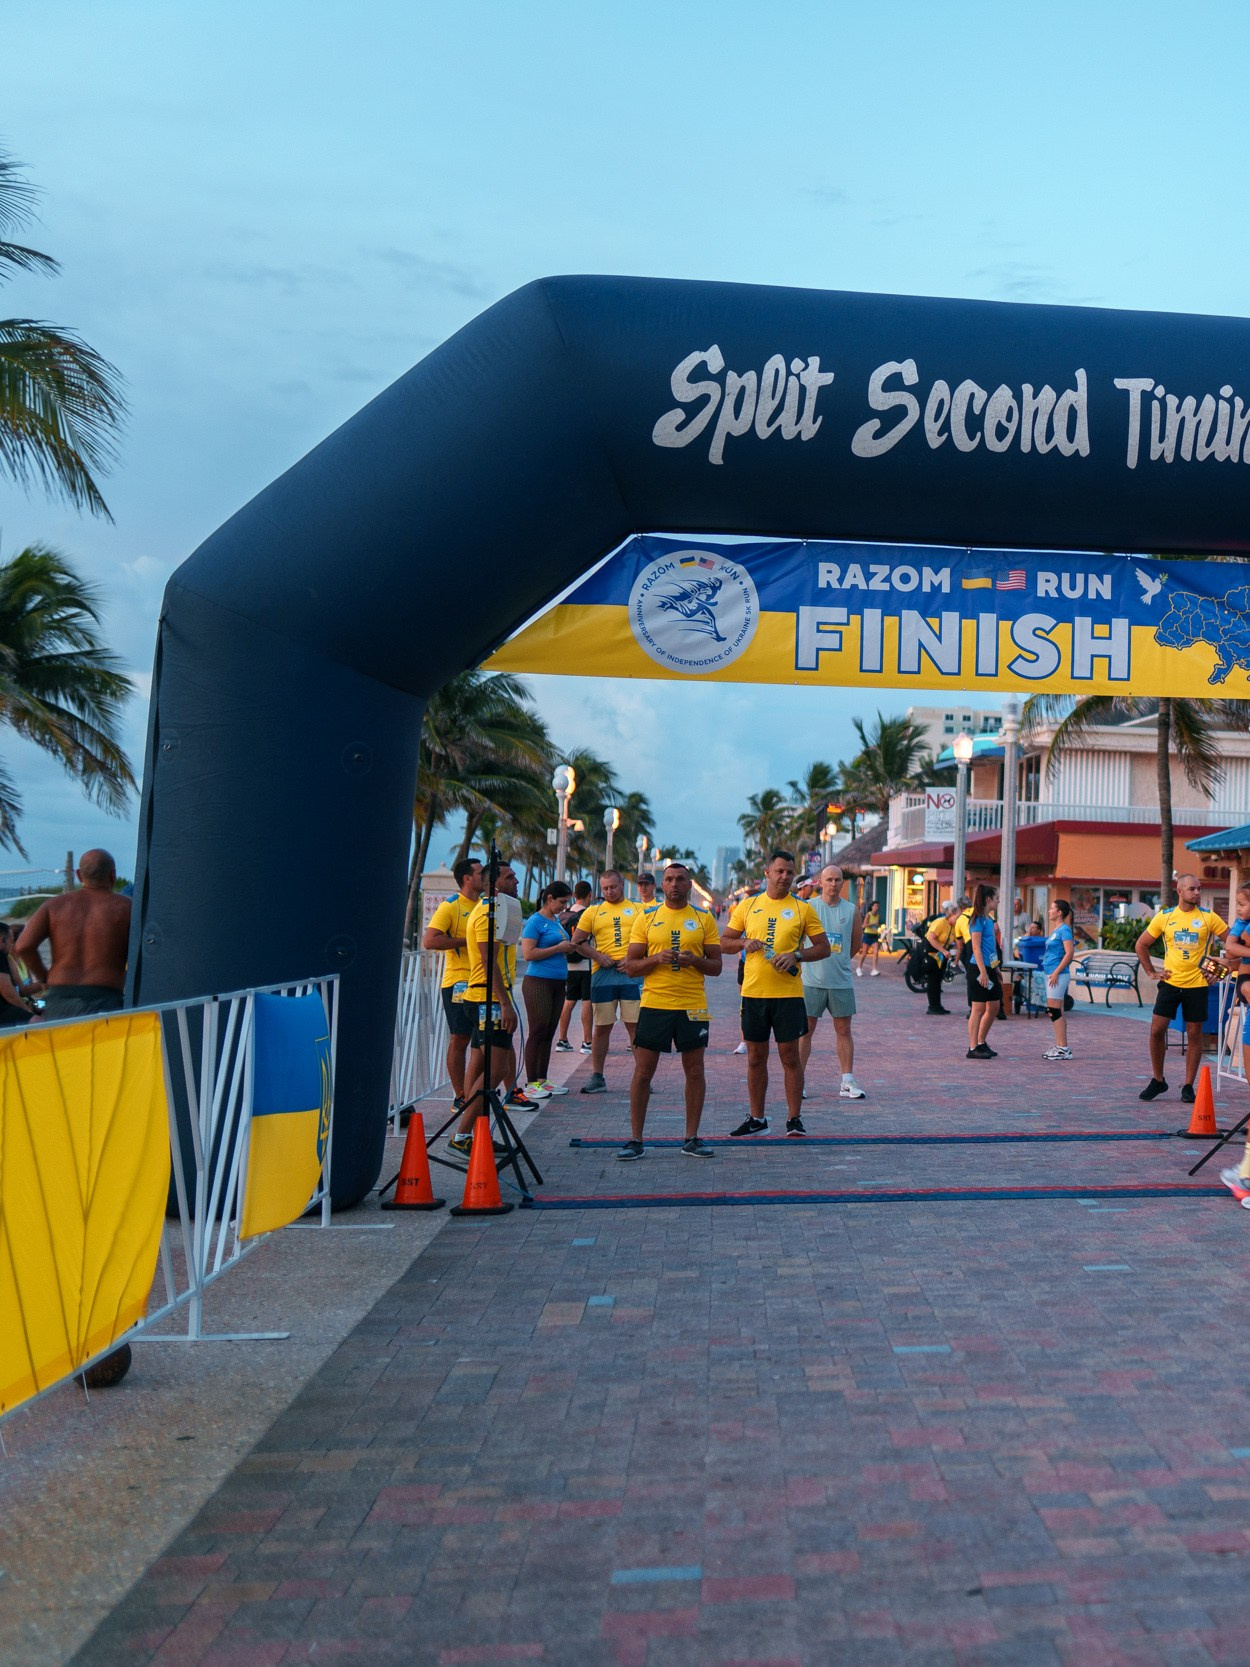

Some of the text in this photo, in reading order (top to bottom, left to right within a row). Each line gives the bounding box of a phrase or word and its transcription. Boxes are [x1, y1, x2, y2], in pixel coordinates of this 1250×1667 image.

[652, 344, 835, 465] Split
[851, 358, 1090, 458] Second
[642, 562, 675, 591] RAZOM
[818, 562, 1112, 600] RAZOM RUN
[636, 587, 752, 667] ANNIVERSARY OF INDEPENDENCE OF UKRAINE 5K RUN
[795, 606, 1131, 682] FINISH
[613, 916, 622, 948] UKRAINE
[401, 1178, 419, 1187] SST
